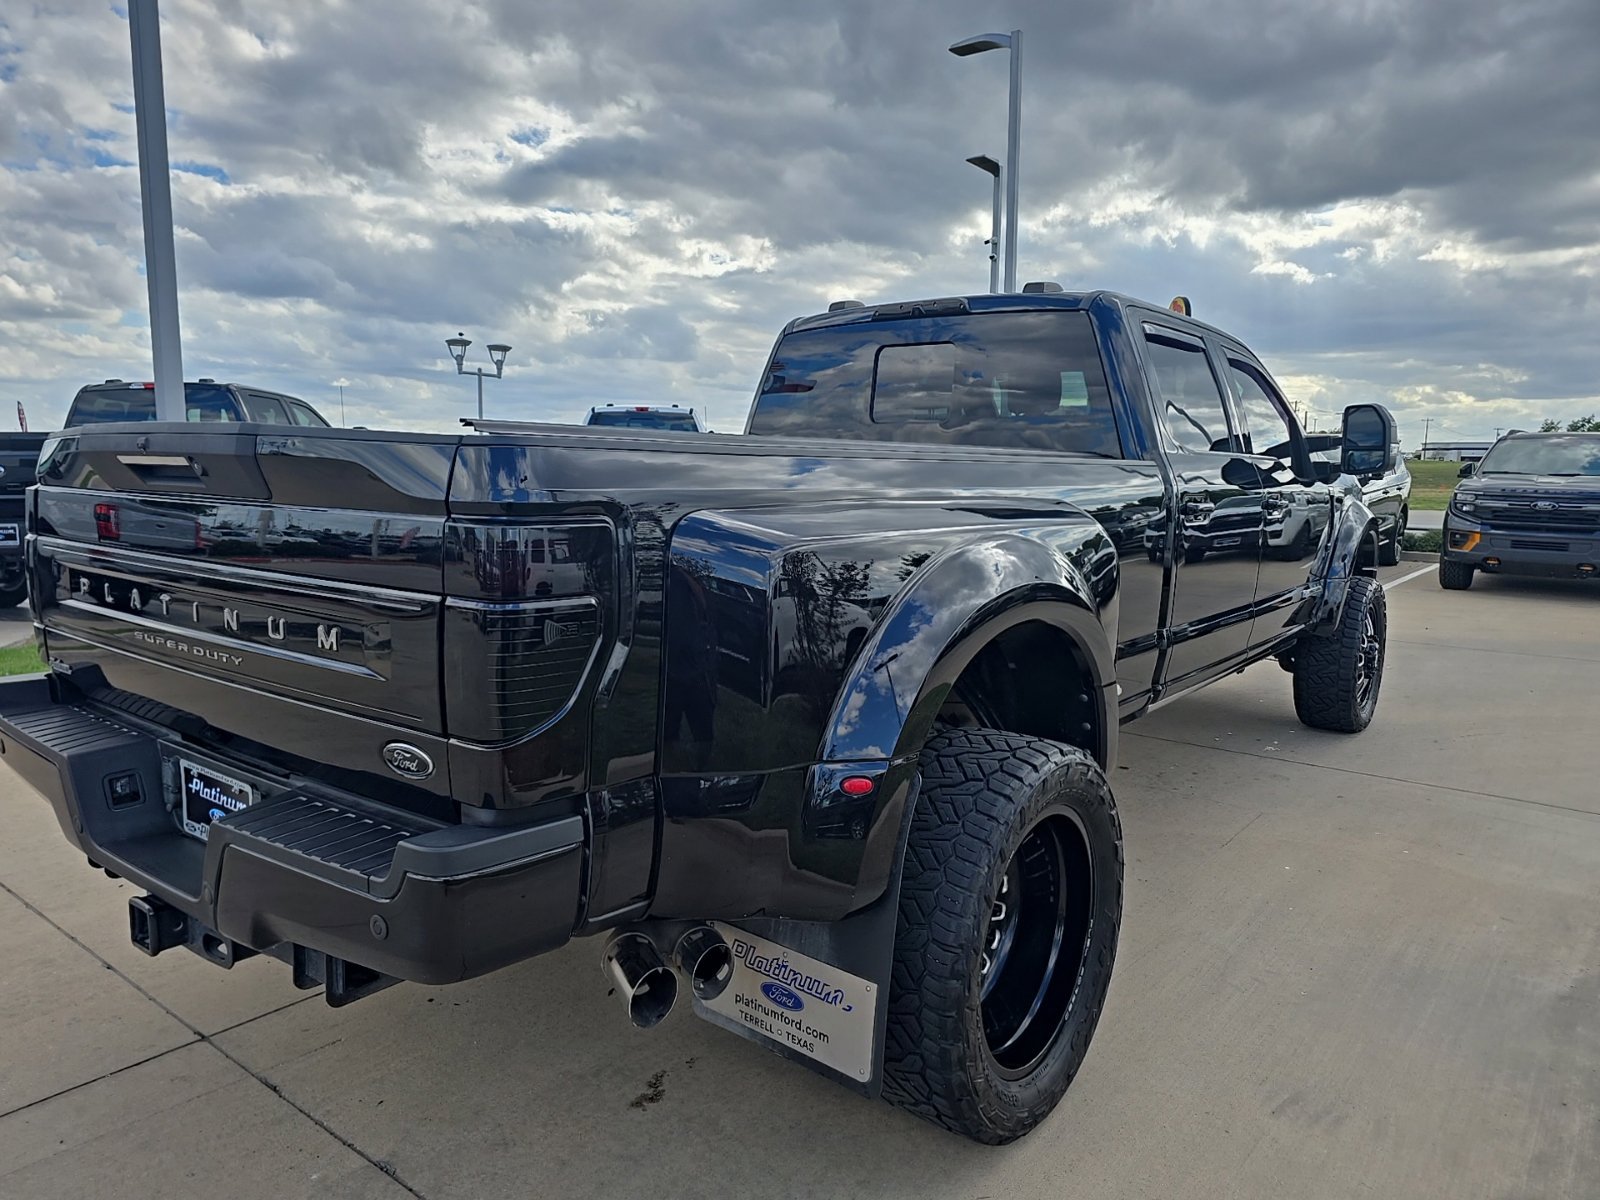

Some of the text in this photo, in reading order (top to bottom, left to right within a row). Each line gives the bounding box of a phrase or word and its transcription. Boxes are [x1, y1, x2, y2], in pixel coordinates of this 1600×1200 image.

[79, 575, 341, 651] PLATINUM
[134, 631, 243, 665] SUPER DUTY
[392, 749, 419, 771] Ford
[188, 778, 247, 812] Platinum
[732, 938, 853, 1012] Platinum
[769, 985, 795, 1008] Ford
[734, 992, 830, 1044] platinumford.com
[738, 1009, 815, 1054] TERRELL TEXAS
